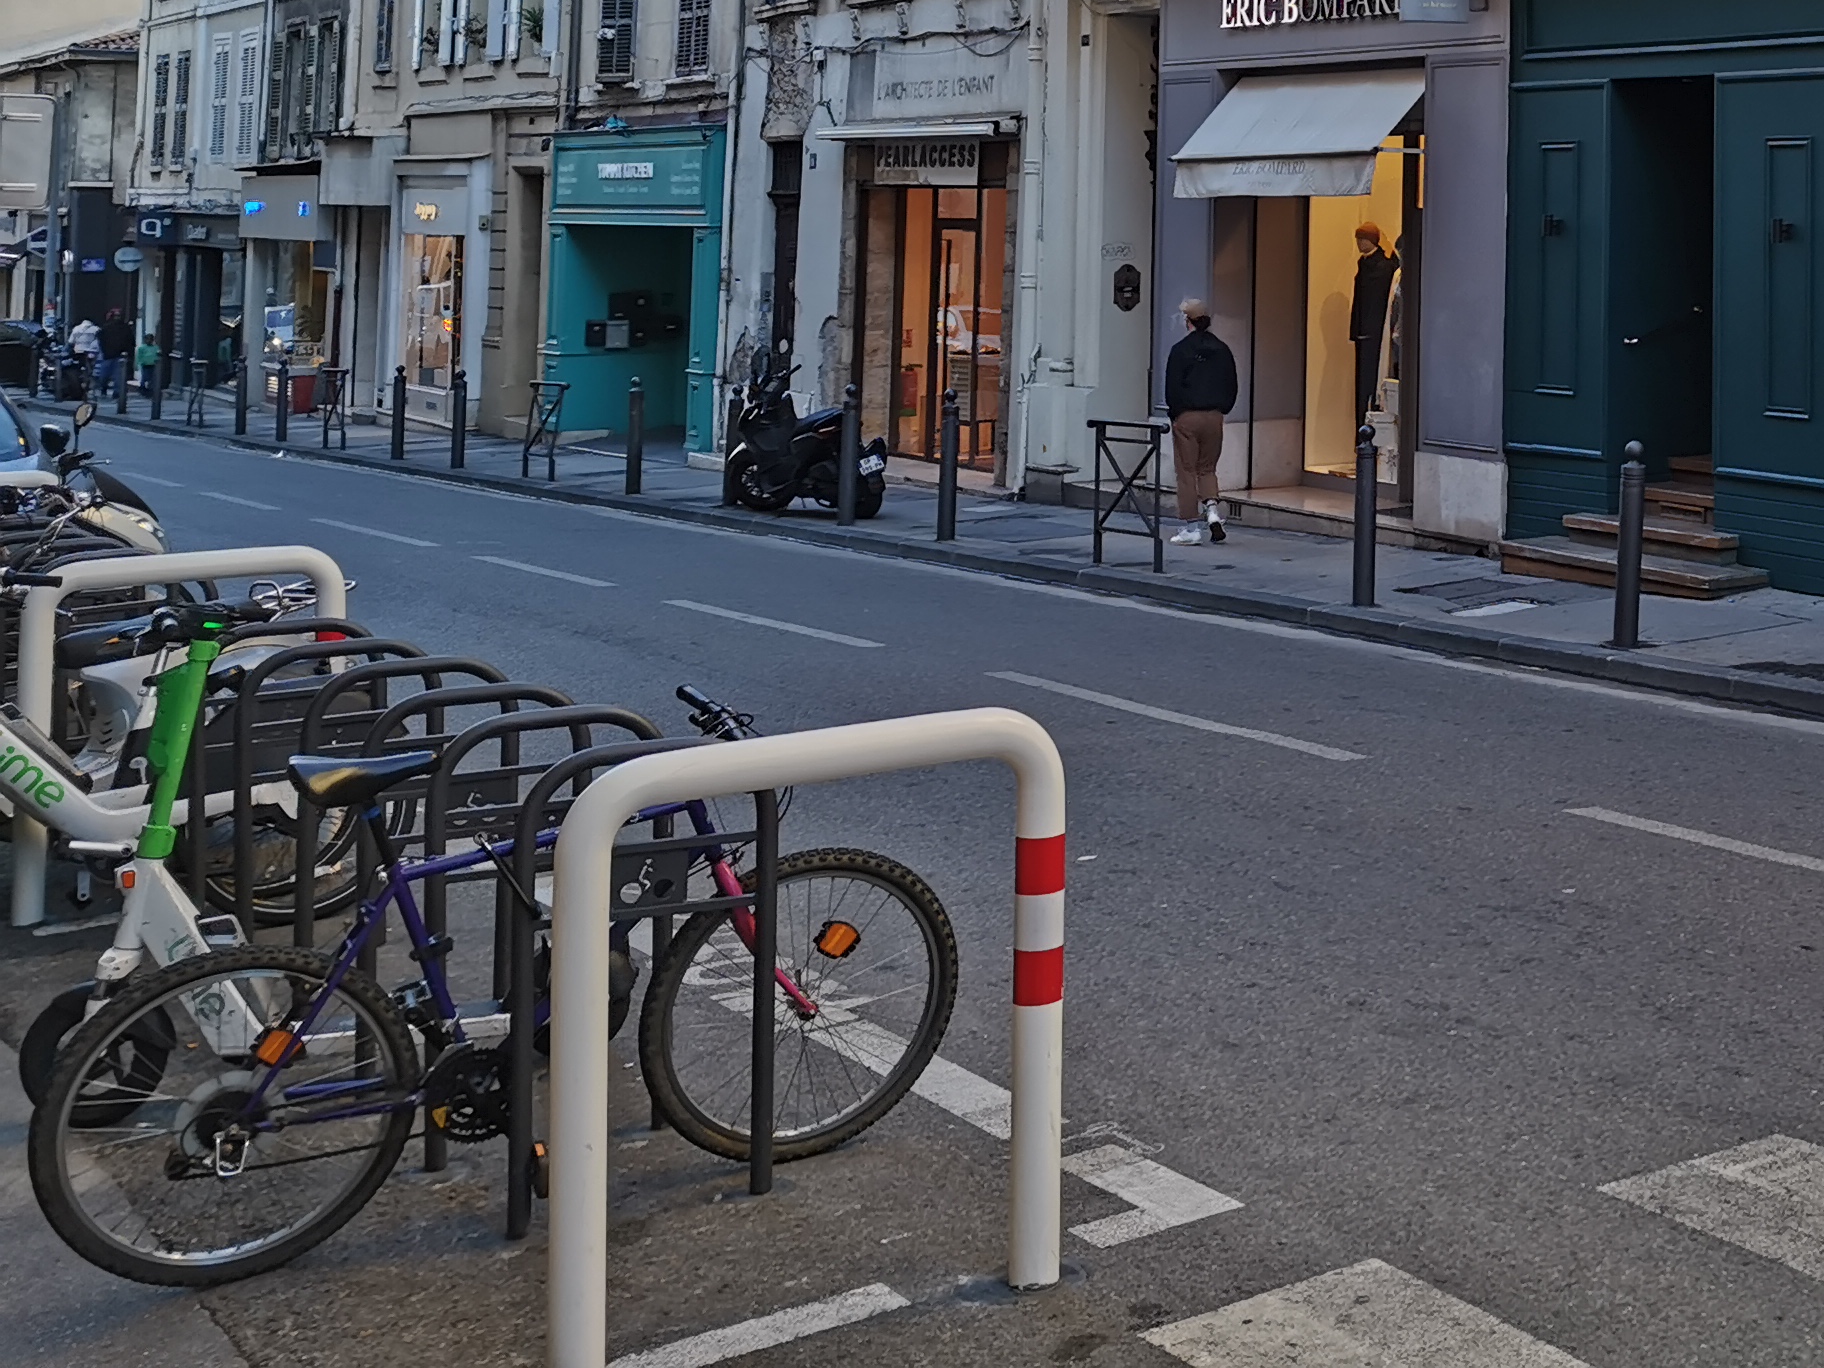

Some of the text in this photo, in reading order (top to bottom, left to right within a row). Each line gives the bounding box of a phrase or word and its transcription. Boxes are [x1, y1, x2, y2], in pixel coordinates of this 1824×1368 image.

[876, 74, 995, 101] L'ARCHITECTE DE L'ENFANT
[876, 143, 977, 168] PEARLACCESS
[1232, 160, 1306, 176] ERIC BOMPARD
